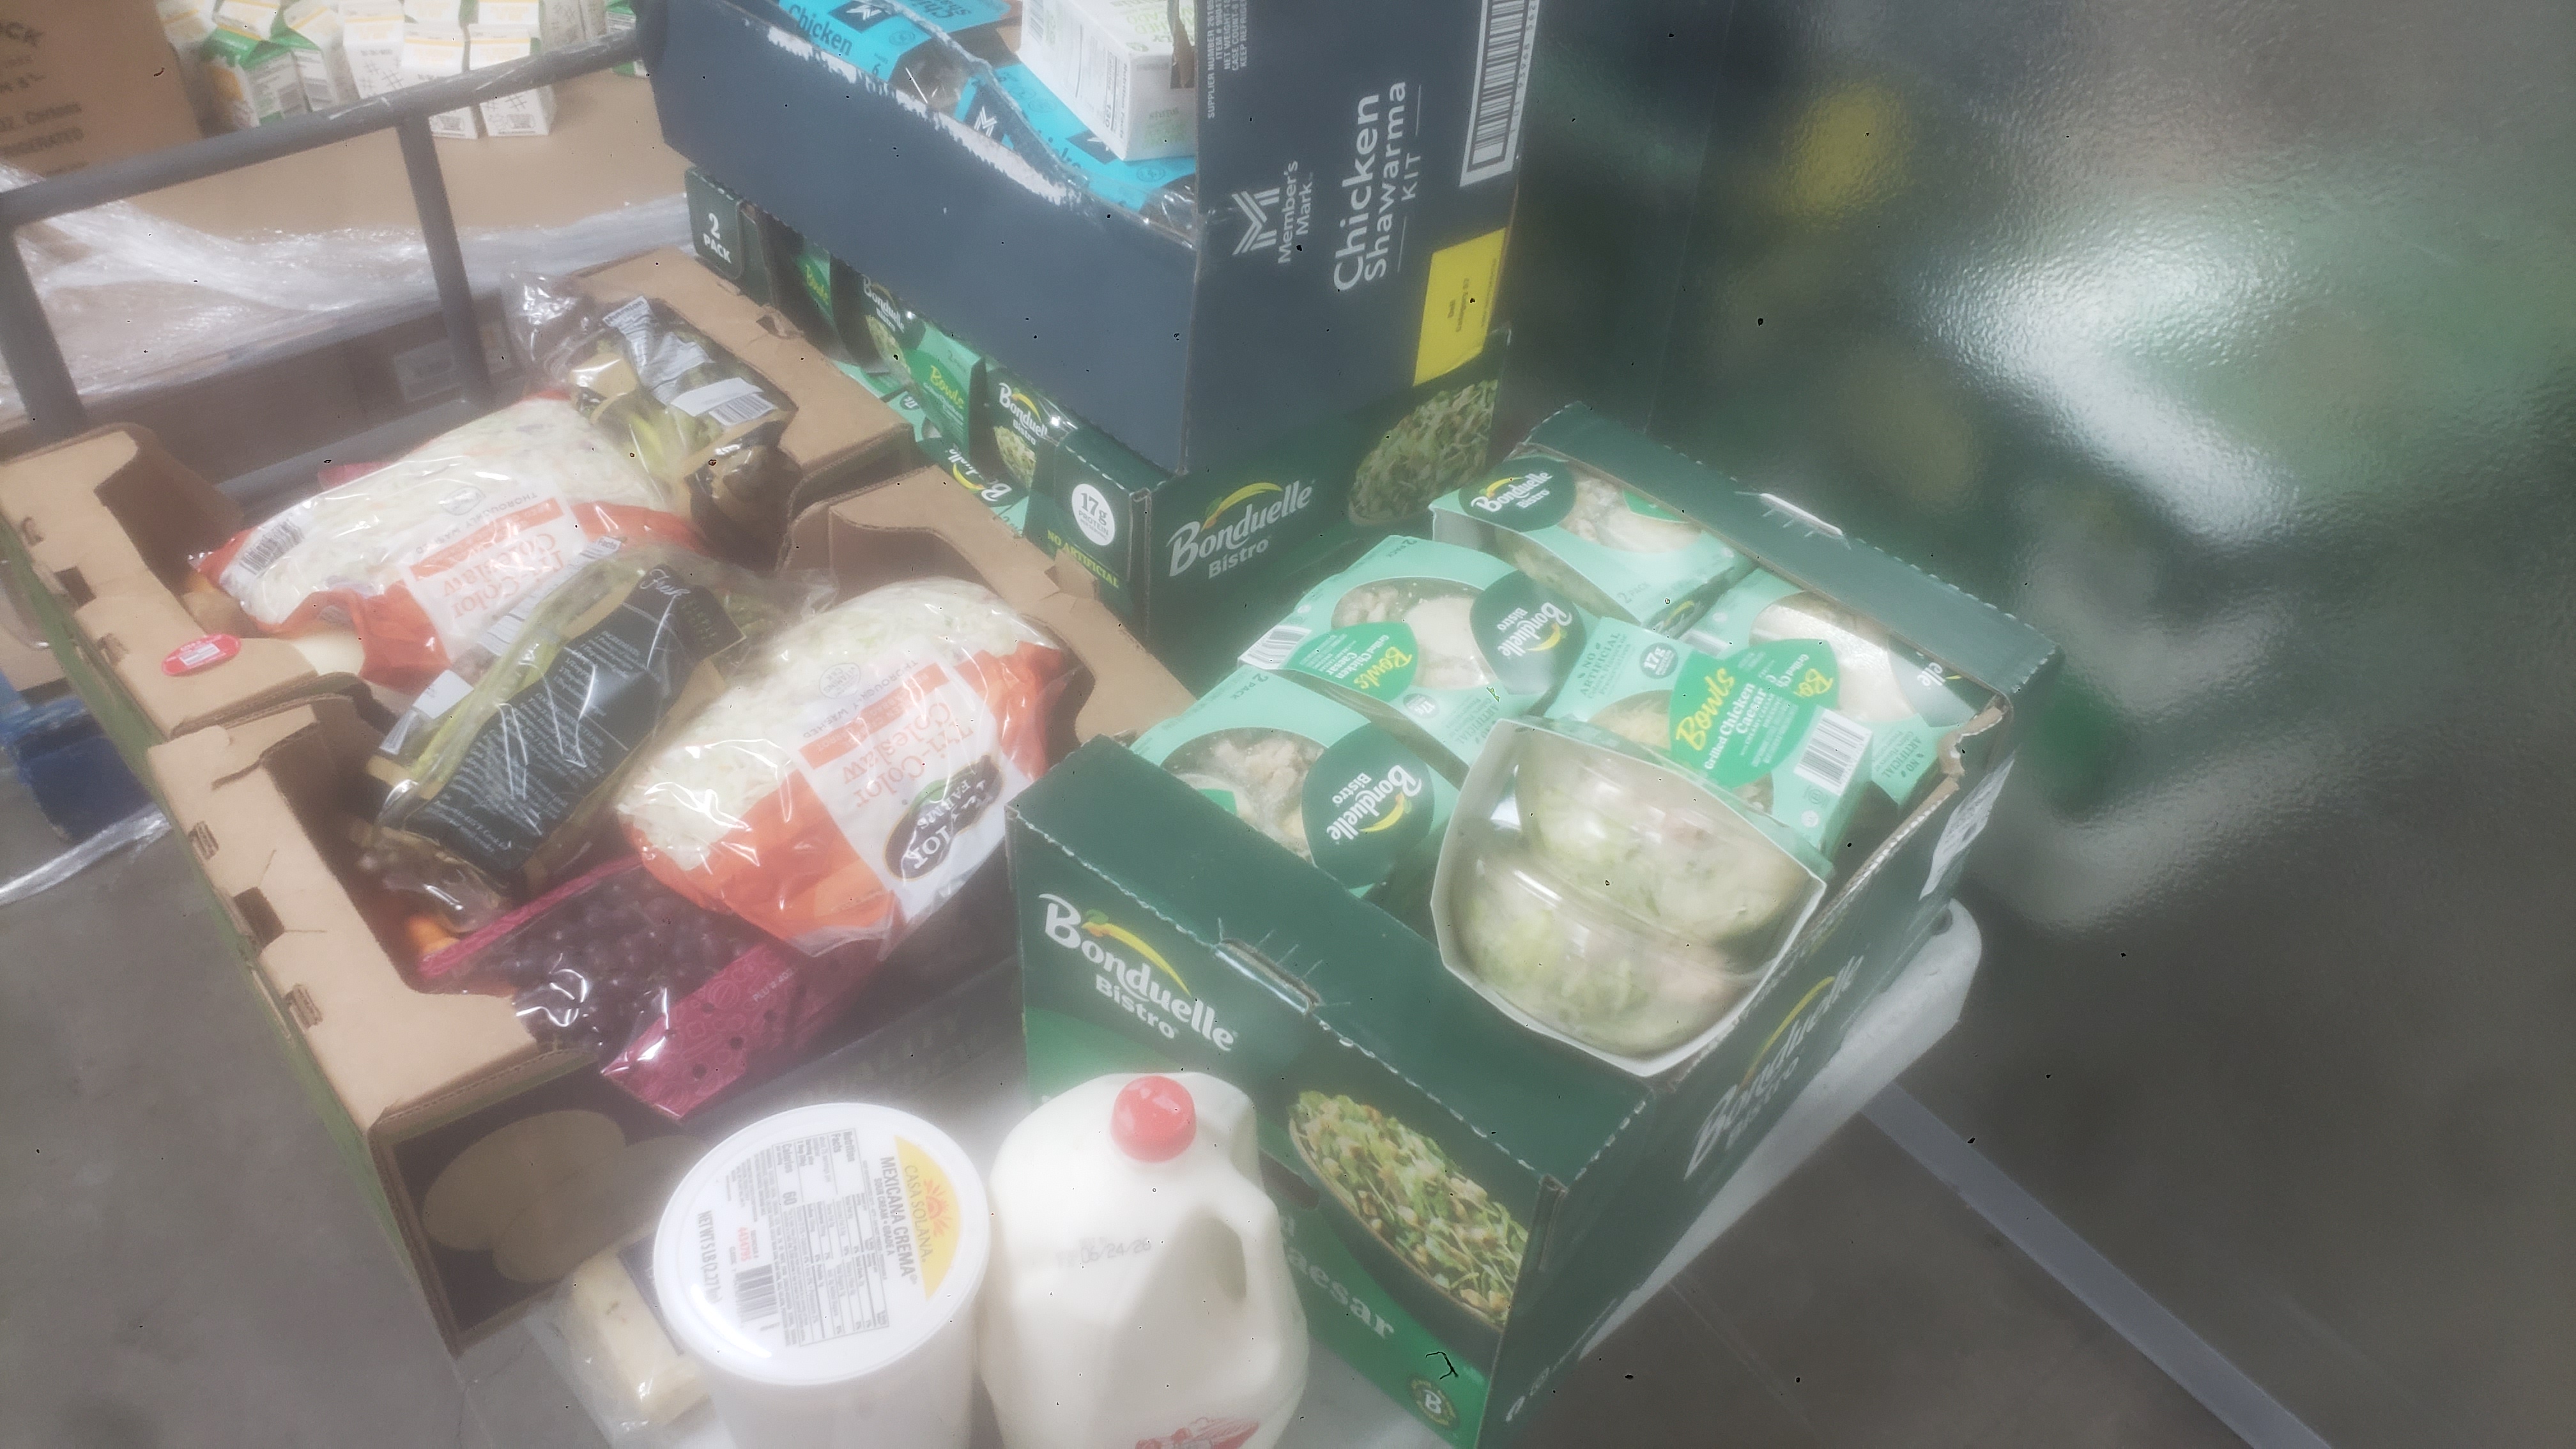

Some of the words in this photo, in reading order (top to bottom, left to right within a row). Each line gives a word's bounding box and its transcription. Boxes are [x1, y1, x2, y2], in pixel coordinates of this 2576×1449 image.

[1334, 94, 1379, 290] Chicken
[1363, 81, 1406, 281] Shawarma
[1401, 153, 1422, 201] KIT
[709, 212, 721, 240] 2
[1278, 160, 1298, 264] Member's
[703, 233, 732, 264] PACK
[931, 365, 964, 410] Bowls
[1013, 418, 1036, 445] Bistro
[1471, 471, 1553, 512] Bonduelle
[1515, 488, 1551, 509] Bistro
[1079, 510, 1109, 535] PROTEIN
[1080, 493, 1107, 526] 17g
[414, 527, 462, 555] WASED
[1166, 480, 1313, 577] Bonduelle
[1047, 529, 1062, 546] NO
[1062, 541, 1119, 588] ARTIFICIAL
[1208, 538, 1269, 579] Bistro
[1496, 607, 1529, 631] Bistro
[1497, 602, 1572, 657] Bonduelle
[1325, 651, 1358, 675] Caesar
[1335, 652, 1372, 679] Chicken
[1353, 646, 1413, 689] Bowls
[1578, 631, 1621, 696] ARTIFICIAL
[1581, 651, 1597, 670] NO
[1642, 644, 1666, 673] 17g
[1229, 681, 1256, 700] PACK
[1252, 672, 1269, 682] 2
[802, 705, 849, 739] WASHED
[1675, 668, 1735, 751] Bowls
[1704, 736, 1728, 770] Grilled
[1719, 682, 1756, 737] Chicken
[1735, 687, 1768, 735] Caesar
[842, 702, 952, 785] Coleslaw
[856, 710, 973, 808] Tri-Color
[1877, 735, 1926, 779] ARTIFICIAL
[1326, 764, 1423, 841] Bonduelle
[1331, 771, 1373, 805] Bistro
[1038, 893, 1234, 1052] Bonduelle
[752, 986, 770, 1002] PLU
[1095, 974, 1176, 1039] Bistro
[1683, 955, 1864, 1181] Bonduelle
[780, 1143, 796, 1173] Calories
[831, 1133, 843, 1153] Facts
[843, 1131, 857, 1162] Nutrition
[782, 1191, 798, 1206] 60
[873, 1177, 885, 1195] SOUR
[880, 1155, 907, 1224] MEXICANA
[904, 1164, 922, 1199] CASA
[696, 1210, 714, 1228] NET
[877, 1195, 889, 1220] CREAM
[698, 1227, 716, 1243] WT
[882, 1225, 894, 1249] GRADE
[893, 1225, 916, 1277] CREMA
[701, 1249, 717, 1263] LB
[700, 1262, 721, 1287] (2.27
[1287, 1246, 1395, 1339] aesar
